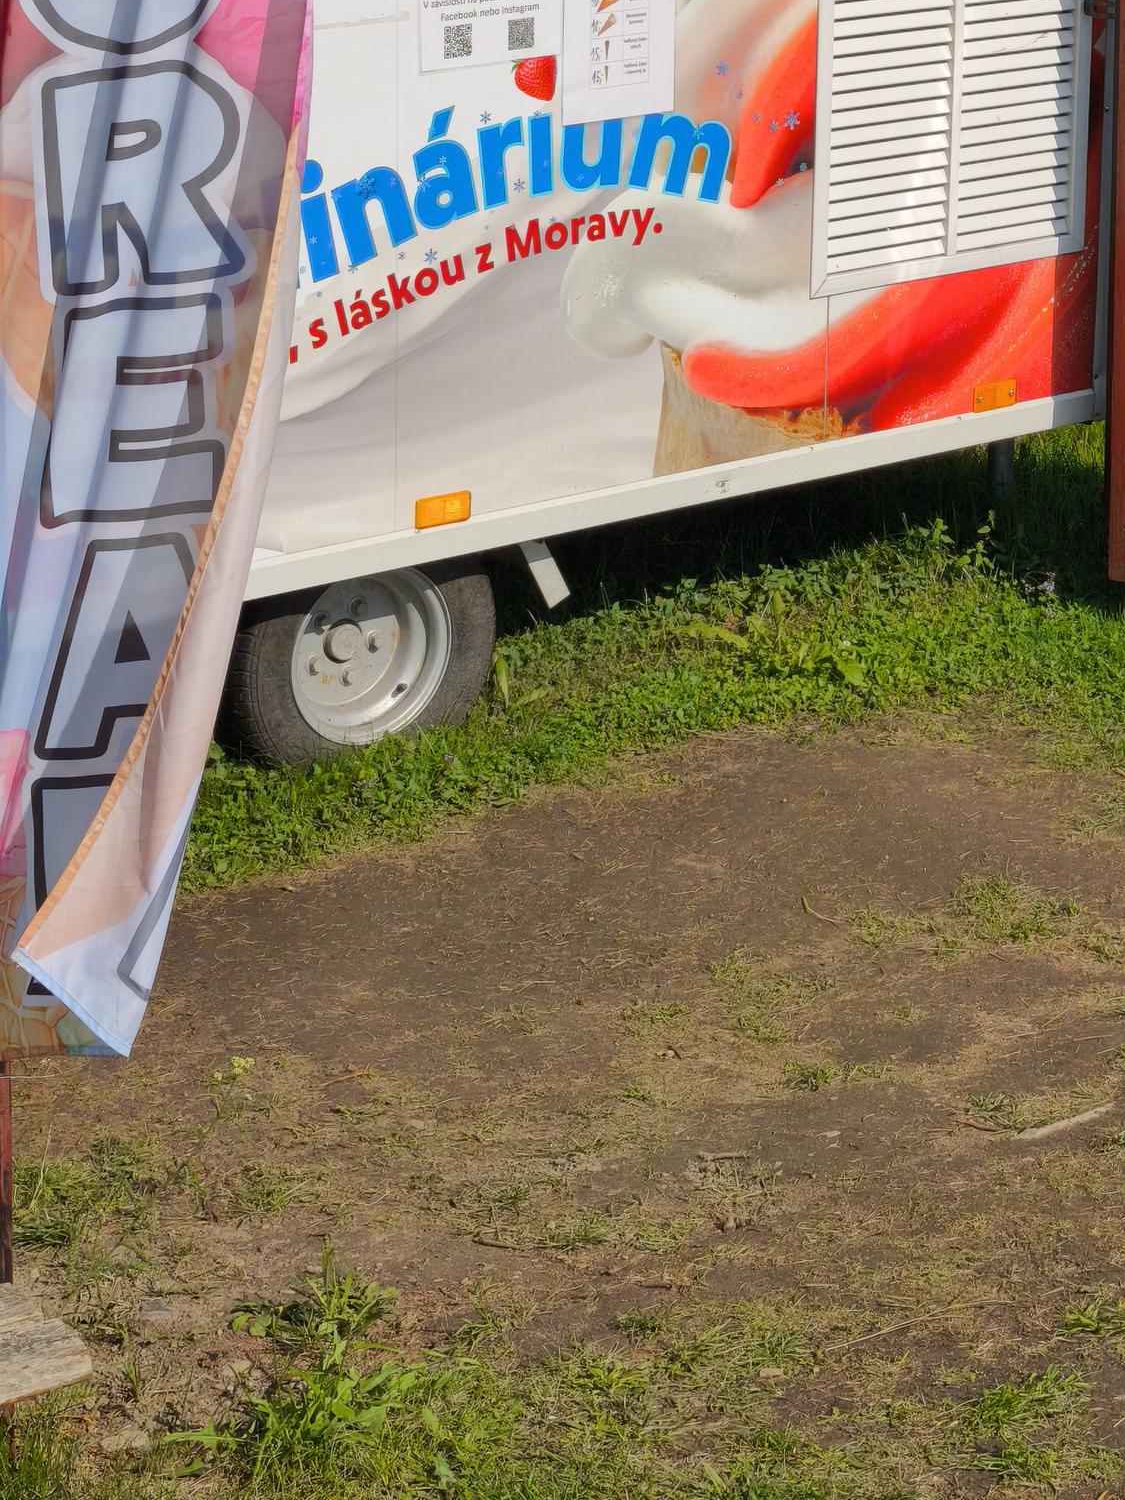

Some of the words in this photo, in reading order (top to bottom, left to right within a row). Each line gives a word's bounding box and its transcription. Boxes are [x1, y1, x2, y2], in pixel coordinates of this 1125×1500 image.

[423, 1, 429, 9] V
[440, 9, 478, 22] Facebook
[479, 7, 500, 17] nebo
[501, 3, 540, 16] instagram
[296, 105, 732, 288] inárium
[309, 317, 329, 350] s
[333, 253, 465, 337] láskou
[475, 243, 495, 274] z
[505, 206, 663, 263] Moravy.
